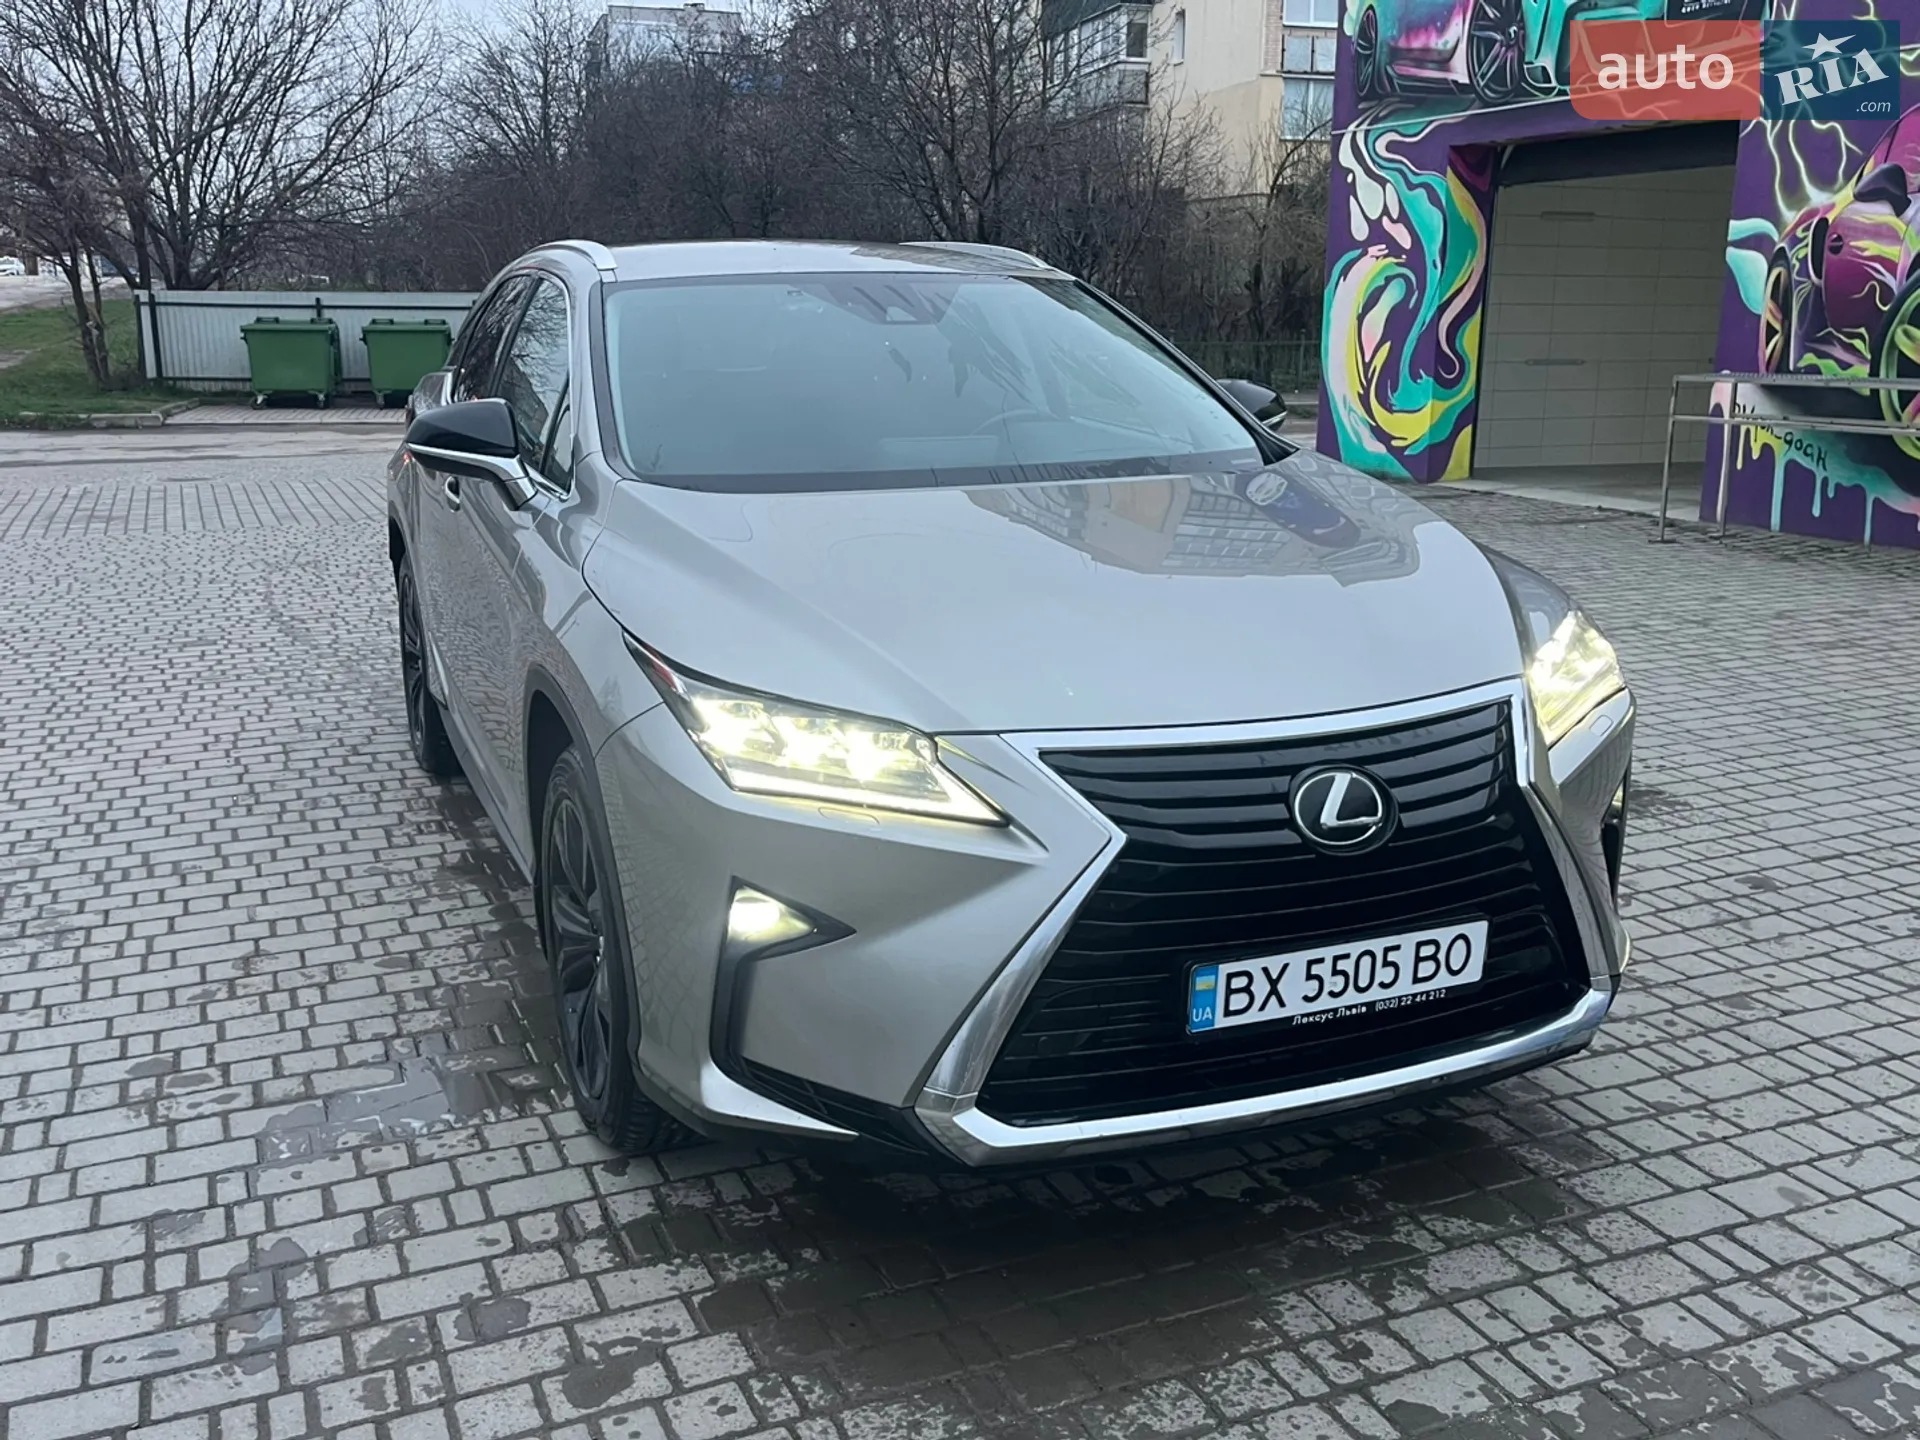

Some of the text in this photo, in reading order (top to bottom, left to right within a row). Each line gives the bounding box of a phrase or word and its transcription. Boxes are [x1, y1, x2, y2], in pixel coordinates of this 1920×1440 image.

[1223, 932, 1472, 1018] BX 5505 BO
[1375, 999, 1399, 1012] (032)
[1400, 997, 1412, 1006] 22
[1415, 994, 1427, 1003] 44
[1429, 989, 1447, 1000] 212
[1192, 1006, 1213, 1022] UA
